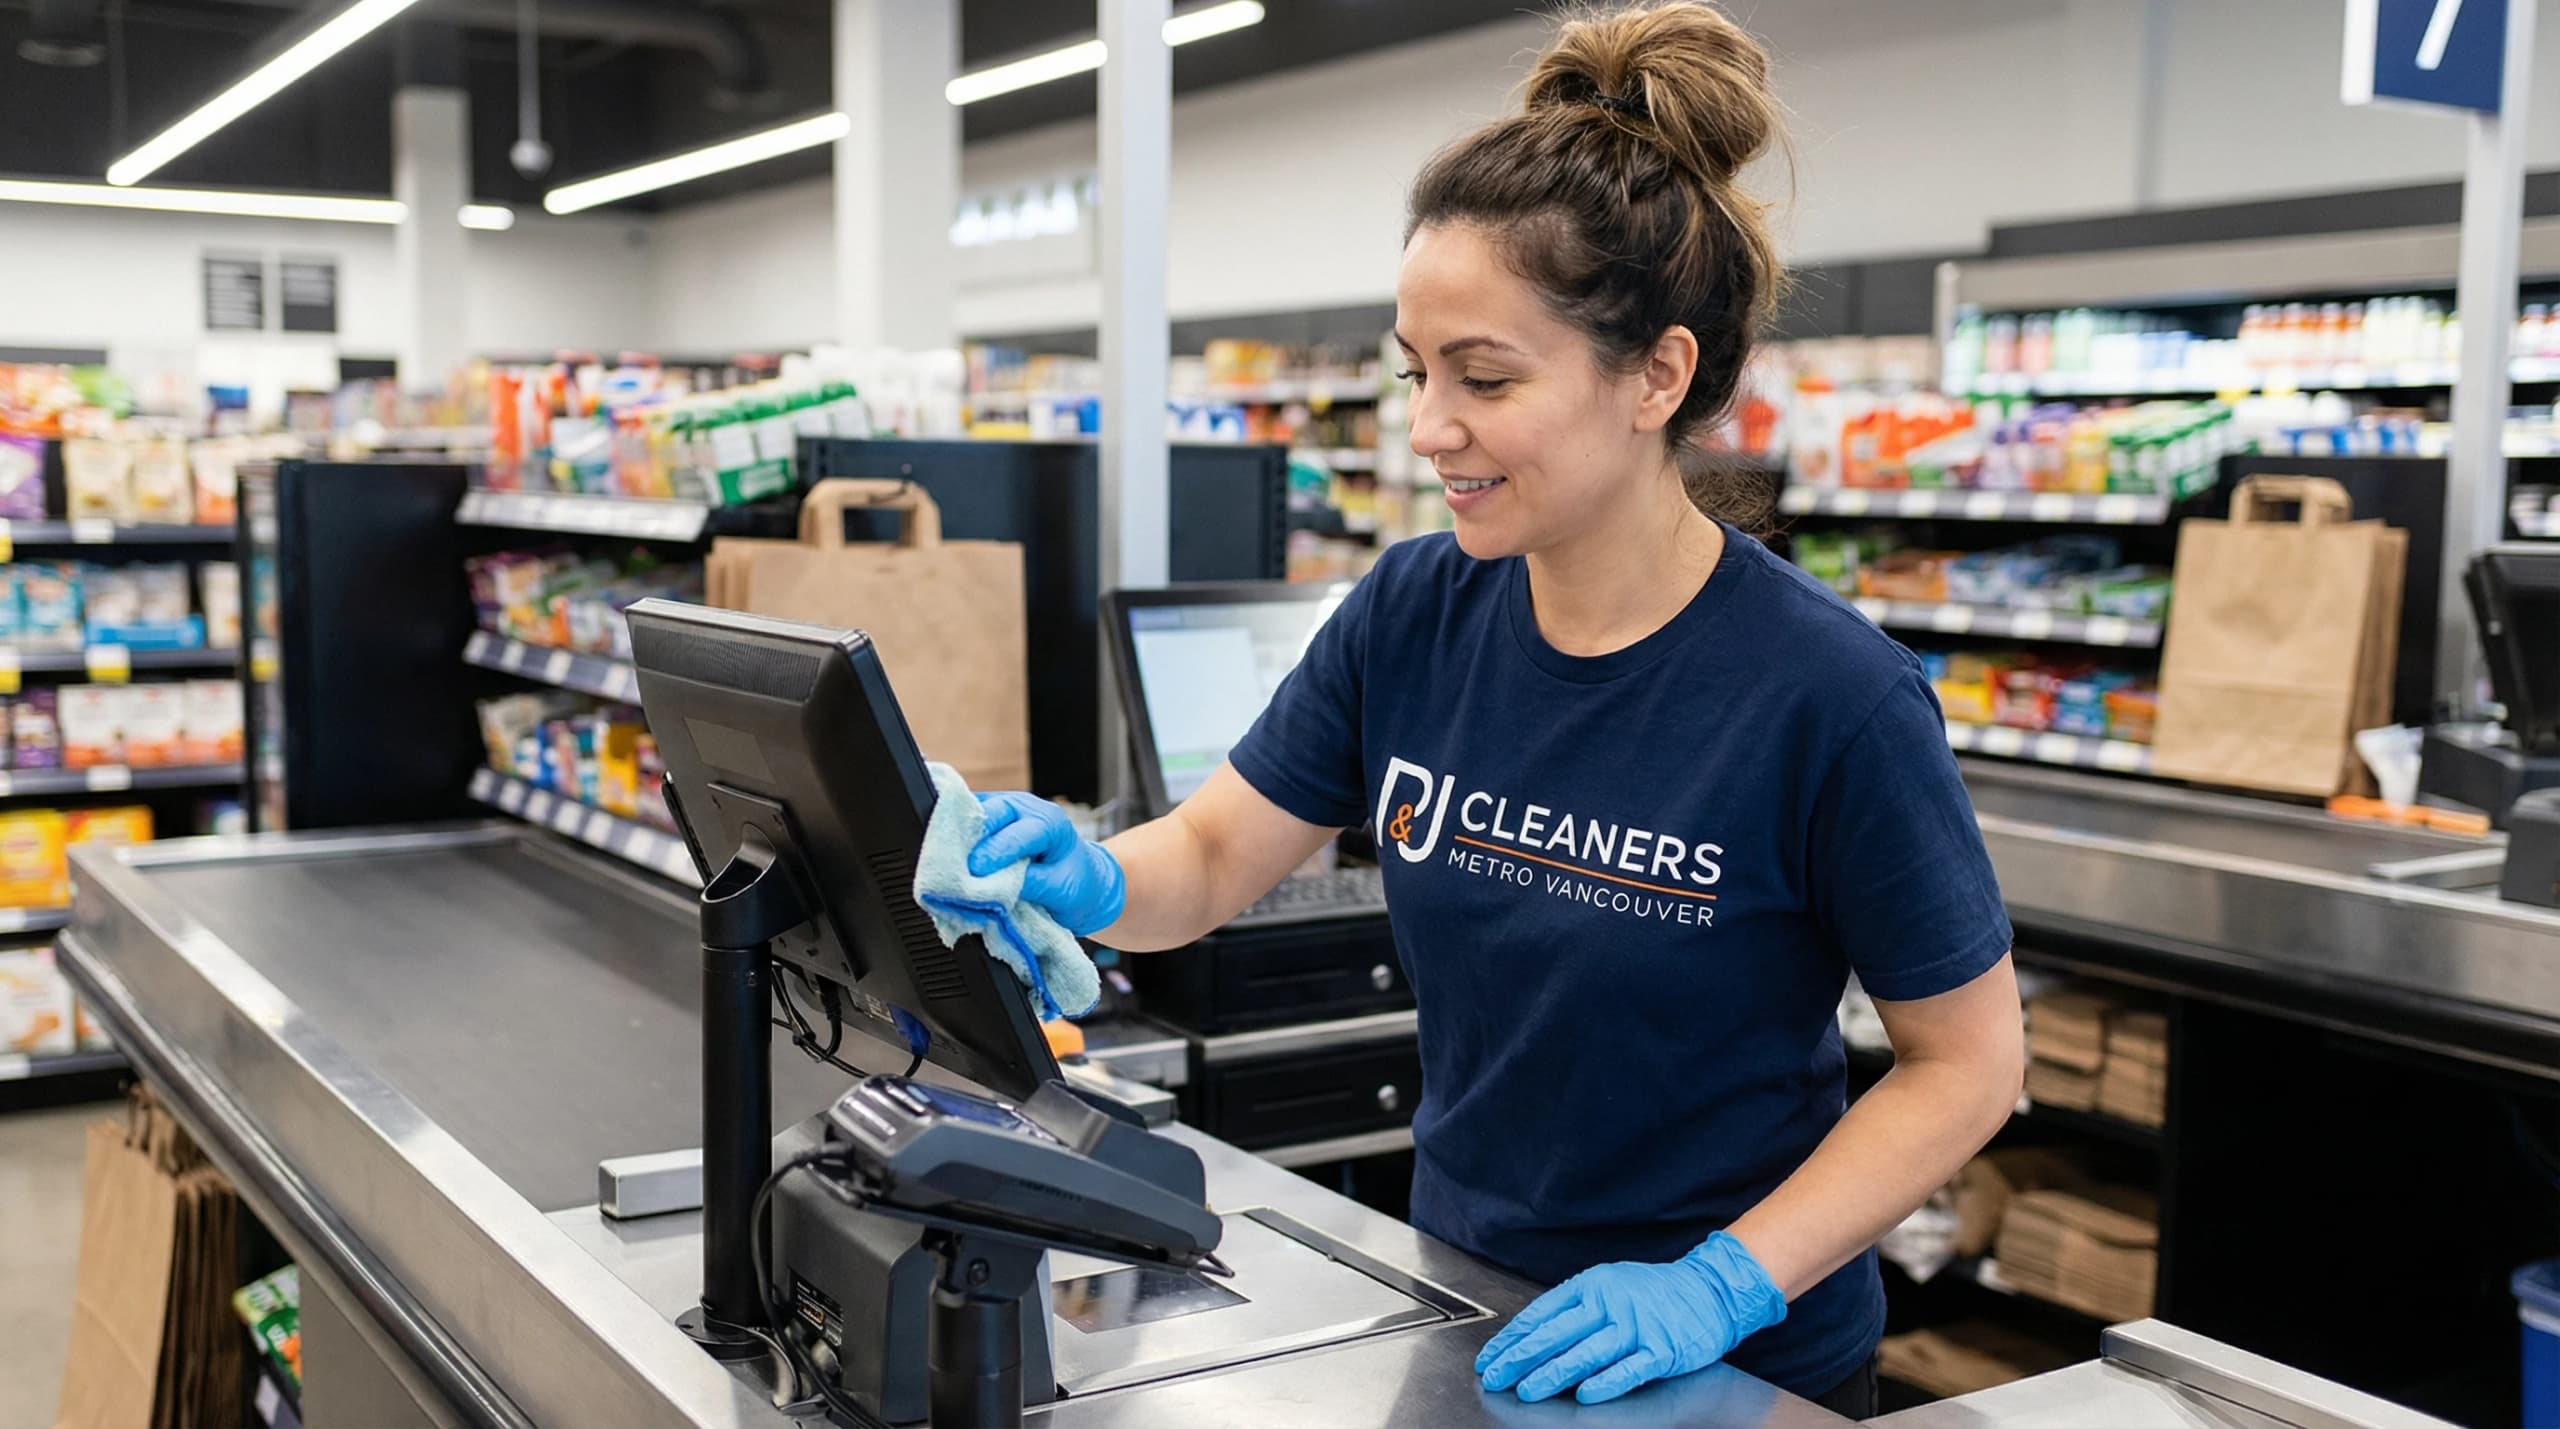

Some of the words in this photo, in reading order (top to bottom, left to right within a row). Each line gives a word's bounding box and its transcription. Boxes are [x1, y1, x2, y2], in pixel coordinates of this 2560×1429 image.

[1460, 791, 1724, 885] CLEANERS
[1448, 848, 1533, 886] METRO
[1546, 873, 1714, 927] VANCOUVER
